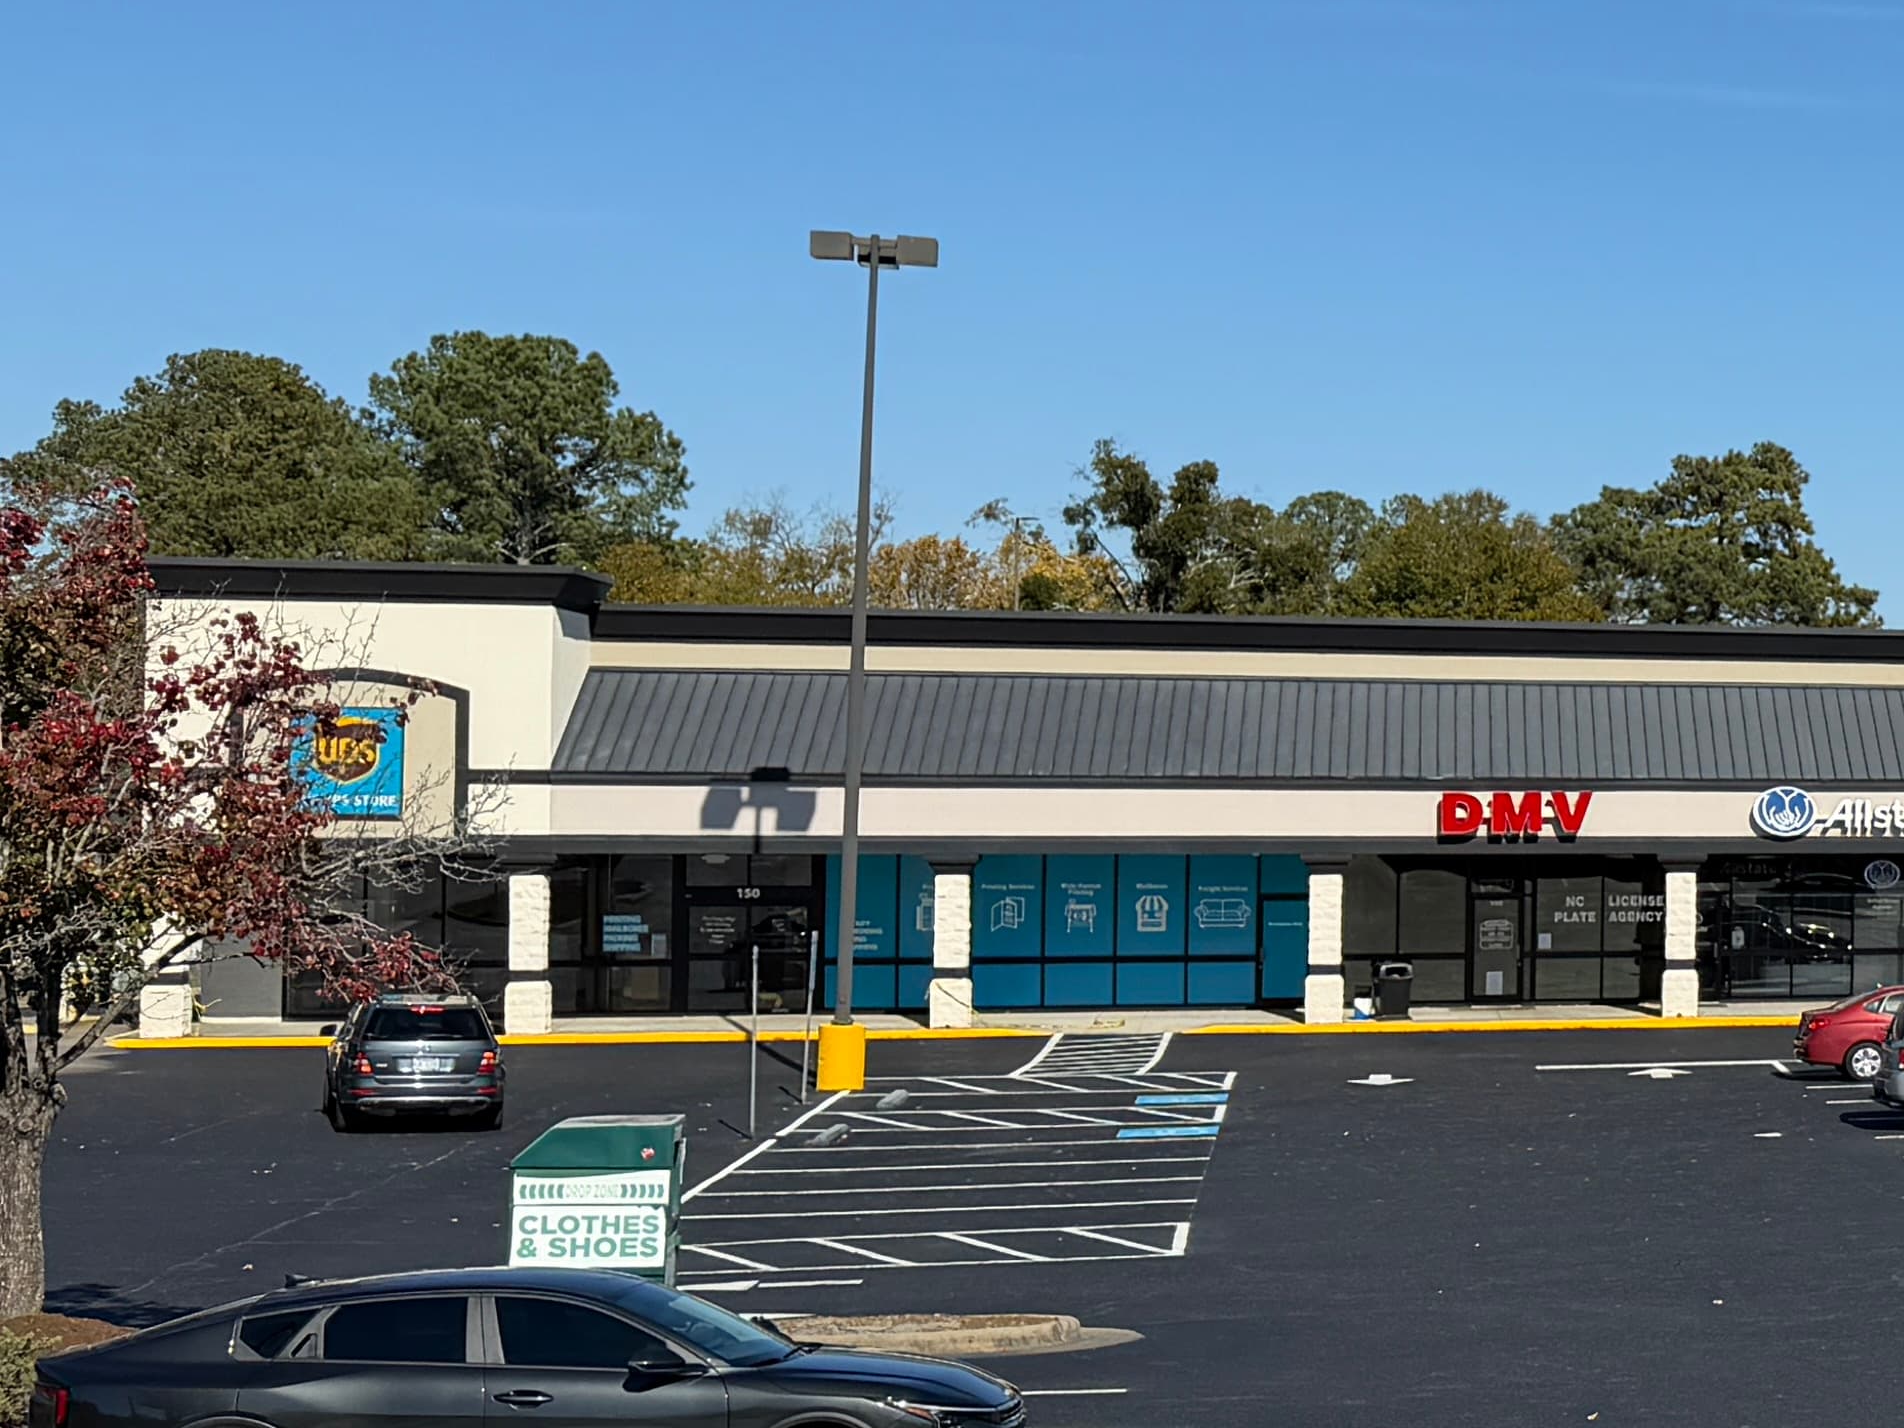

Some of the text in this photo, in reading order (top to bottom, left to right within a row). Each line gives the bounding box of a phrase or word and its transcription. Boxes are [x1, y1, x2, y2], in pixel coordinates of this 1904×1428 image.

[354, 793, 397, 807] STORE
[1440, 790, 1593, 836] DMV
[737, 887, 761, 898] 150
[1566, 896, 1584, 907] NC
[1608, 895, 1664, 907] LICENSE
[1554, 911, 1596, 923] PLATE
[1608, 910, 1664, 922] AGENCY
[565, 1184, 591, 1198] DROP
[518, 1215, 660, 1235] CLOTHES
[516, 1237, 658, 1258] & SHOES
